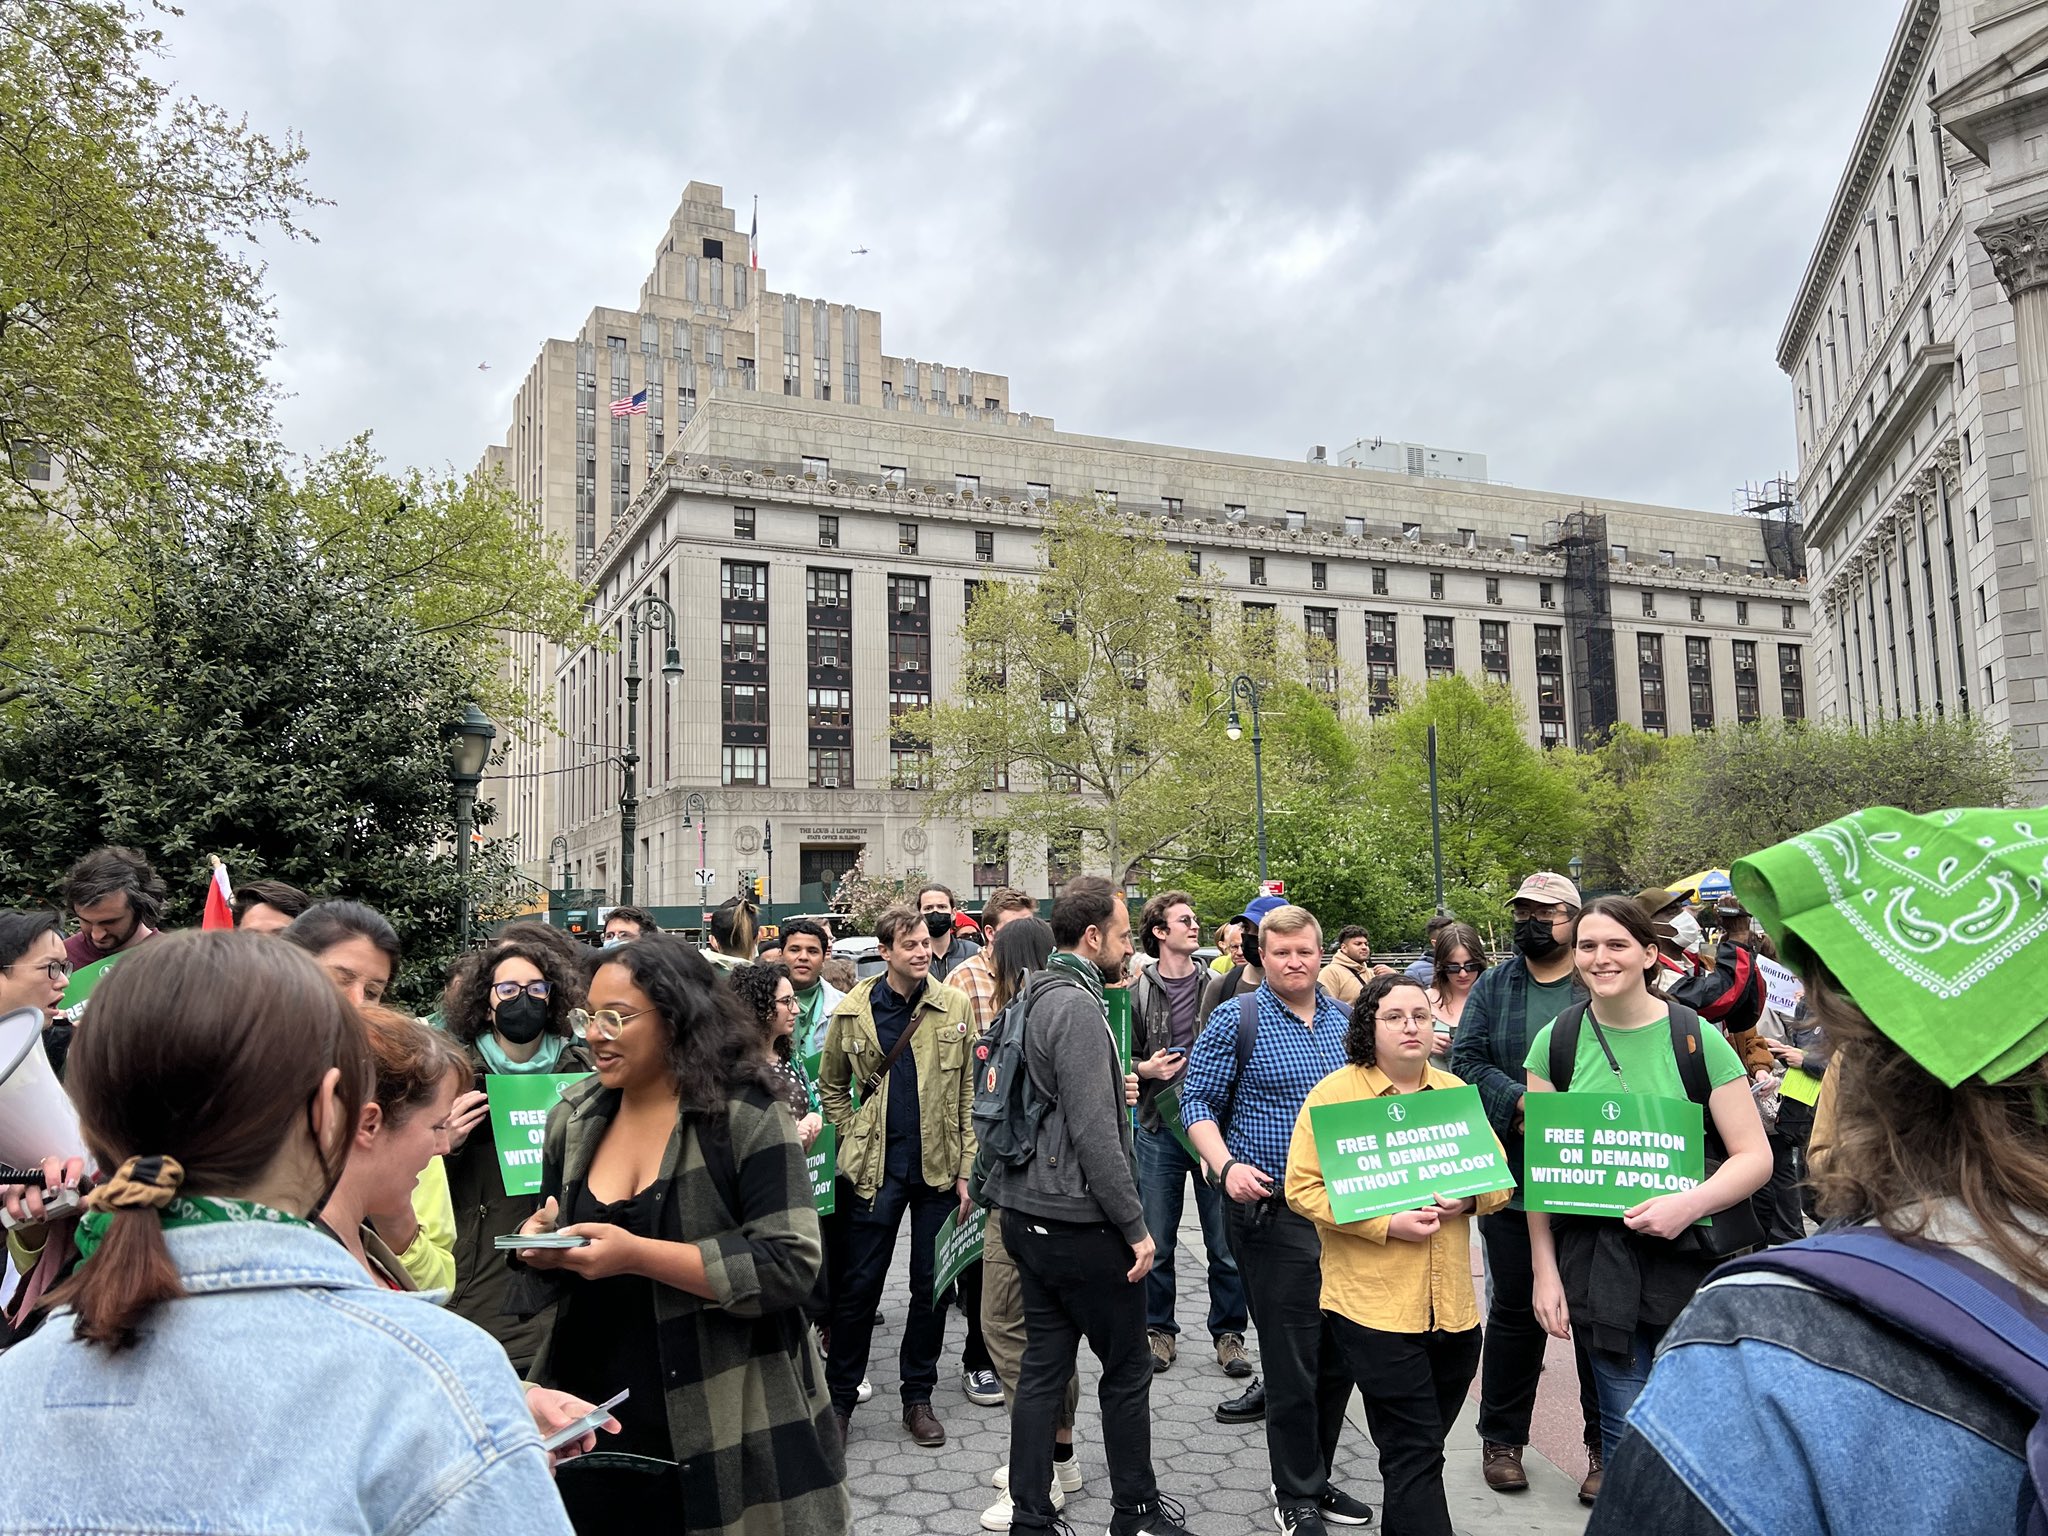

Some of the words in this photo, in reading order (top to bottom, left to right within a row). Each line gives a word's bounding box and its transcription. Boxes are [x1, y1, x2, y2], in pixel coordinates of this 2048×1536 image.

[509, 1110, 546, 1126] FREE
[1336, 1135, 1378, 1155] FREE
[1386, 1121, 1470, 1148] ABORTION
[1544, 1128, 1585, 1144] FREE
[1592, 1129, 1685, 1152] ABORTION
[504, 1149, 543, 1166] WITH
[1357, 1154, 1382, 1171] ON
[1388, 1142, 1460, 1167] DEMAND
[1559, 1148, 1583, 1164] ON
[1591, 1150, 1669, 1169] DEMAND
[1331, 1170, 1409, 1196] WITHOUT
[1418, 1153, 1496, 1181] APOLOGY
[1531, 1167, 1606, 1186] WITHOUT
[1615, 1171, 1699, 1192] APOLOGY
